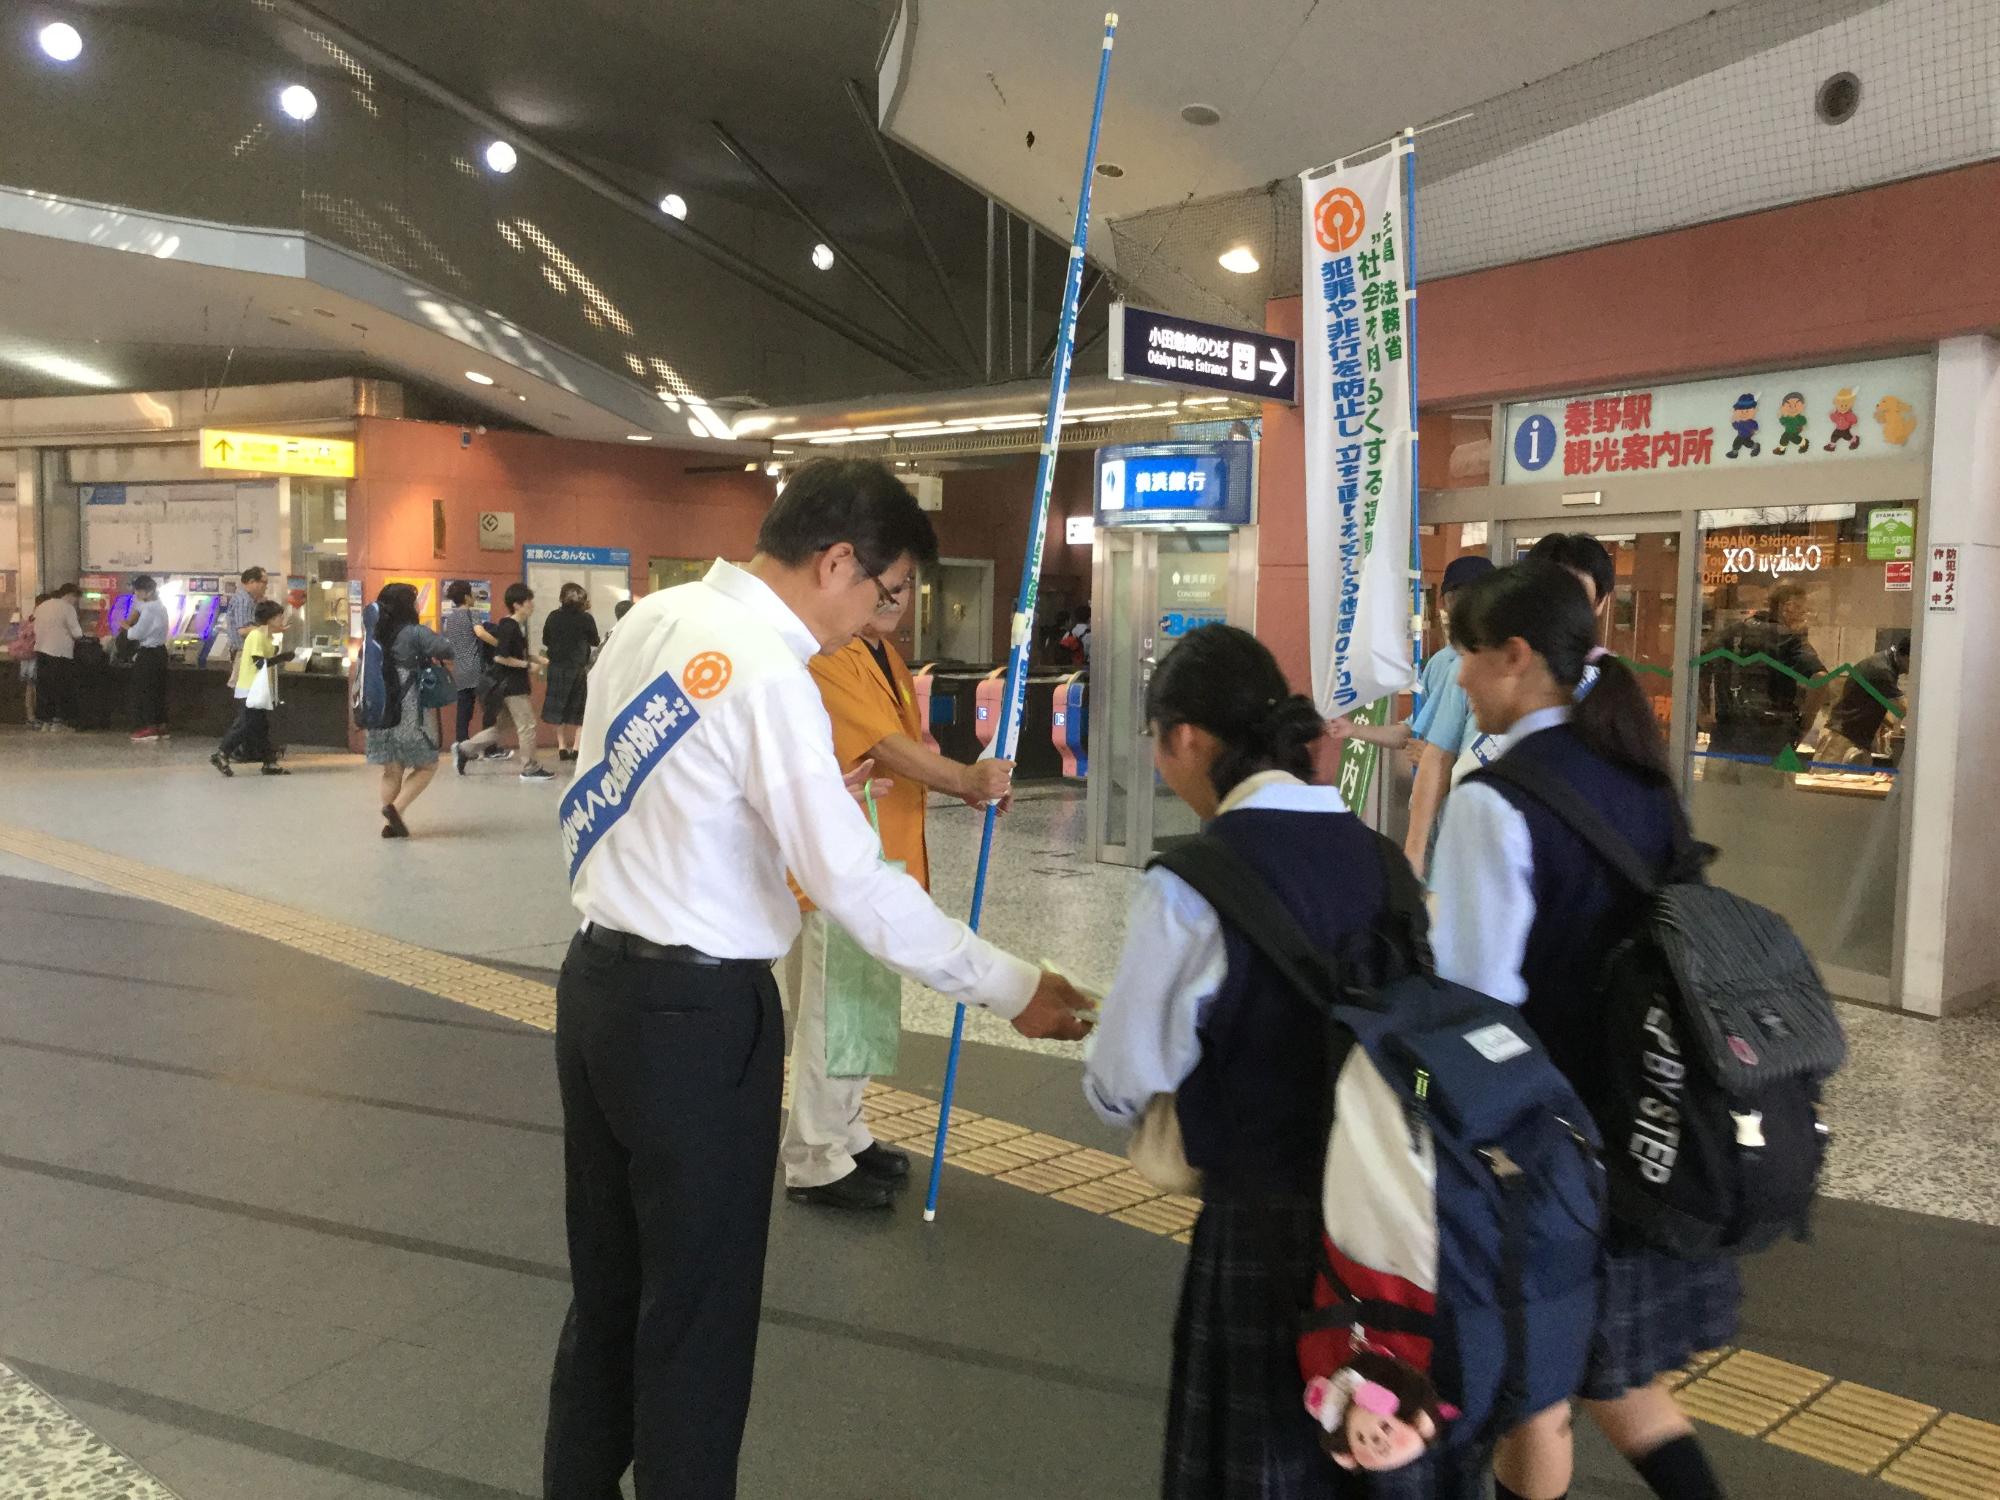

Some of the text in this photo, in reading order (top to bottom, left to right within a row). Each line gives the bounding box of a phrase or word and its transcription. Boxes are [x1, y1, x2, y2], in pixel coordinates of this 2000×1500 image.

[1380, 279, 1402, 363] 法務省
[1147, 349, 1229, 377] Odakyu Line Entrance
[1563, 393, 1652, 438] 秦野駅
[1563, 427, 1714, 477] 観光案内所
[526, 548, 596, 562] 営業のごあんない
[1703, 535, 1756, 549] HADANO
[1702, 571, 1739, 584] Office
[1944, 548, 1957, 605] 防犯カメラ
